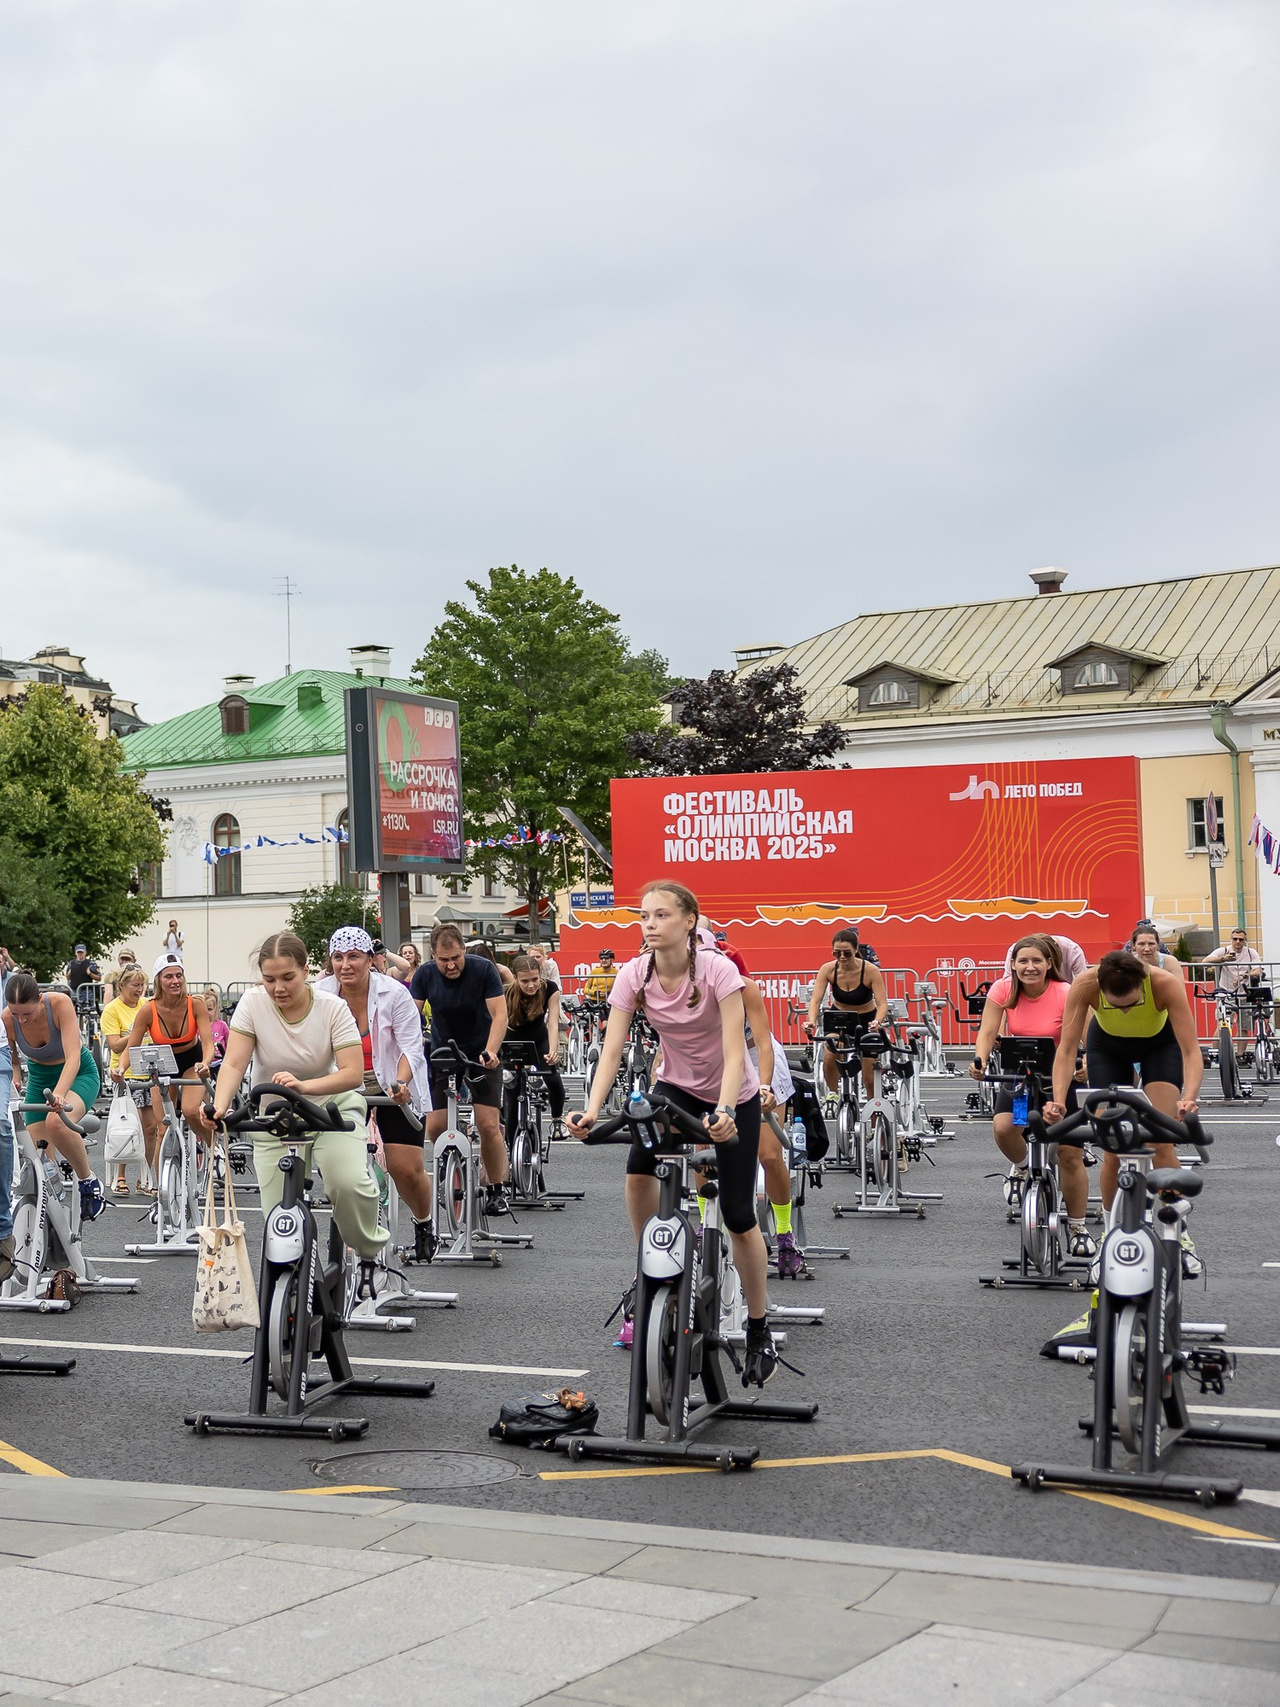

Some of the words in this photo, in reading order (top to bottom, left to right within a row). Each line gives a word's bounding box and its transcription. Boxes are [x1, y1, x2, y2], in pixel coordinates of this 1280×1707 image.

[390, 760, 457, 790] РАССРОЧКА
[411, 790, 418, 808] И
[1004, 784, 1036, 798] ЛЕТО
[1040, 782, 1082, 796] ПОБЕД
[663, 788, 804, 816] ФЕСТИВАЛЬ
[433, 819, 458, 835] LSR.RU
[664, 810, 853, 837] «ОЛИМПИЙСКАЯ
[664, 836, 760, 863] МОСКВА
[767, 835, 837, 860] 2025»
[278, 1219, 292, 1230] GT
[656, 1230, 669, 1243] GT
[1120, 1245, 1137, 1258] GT
[306, 1239, 317, 1313] GYMTOUCH
[688, 1249, 698, 1330] GYMTOUCH
